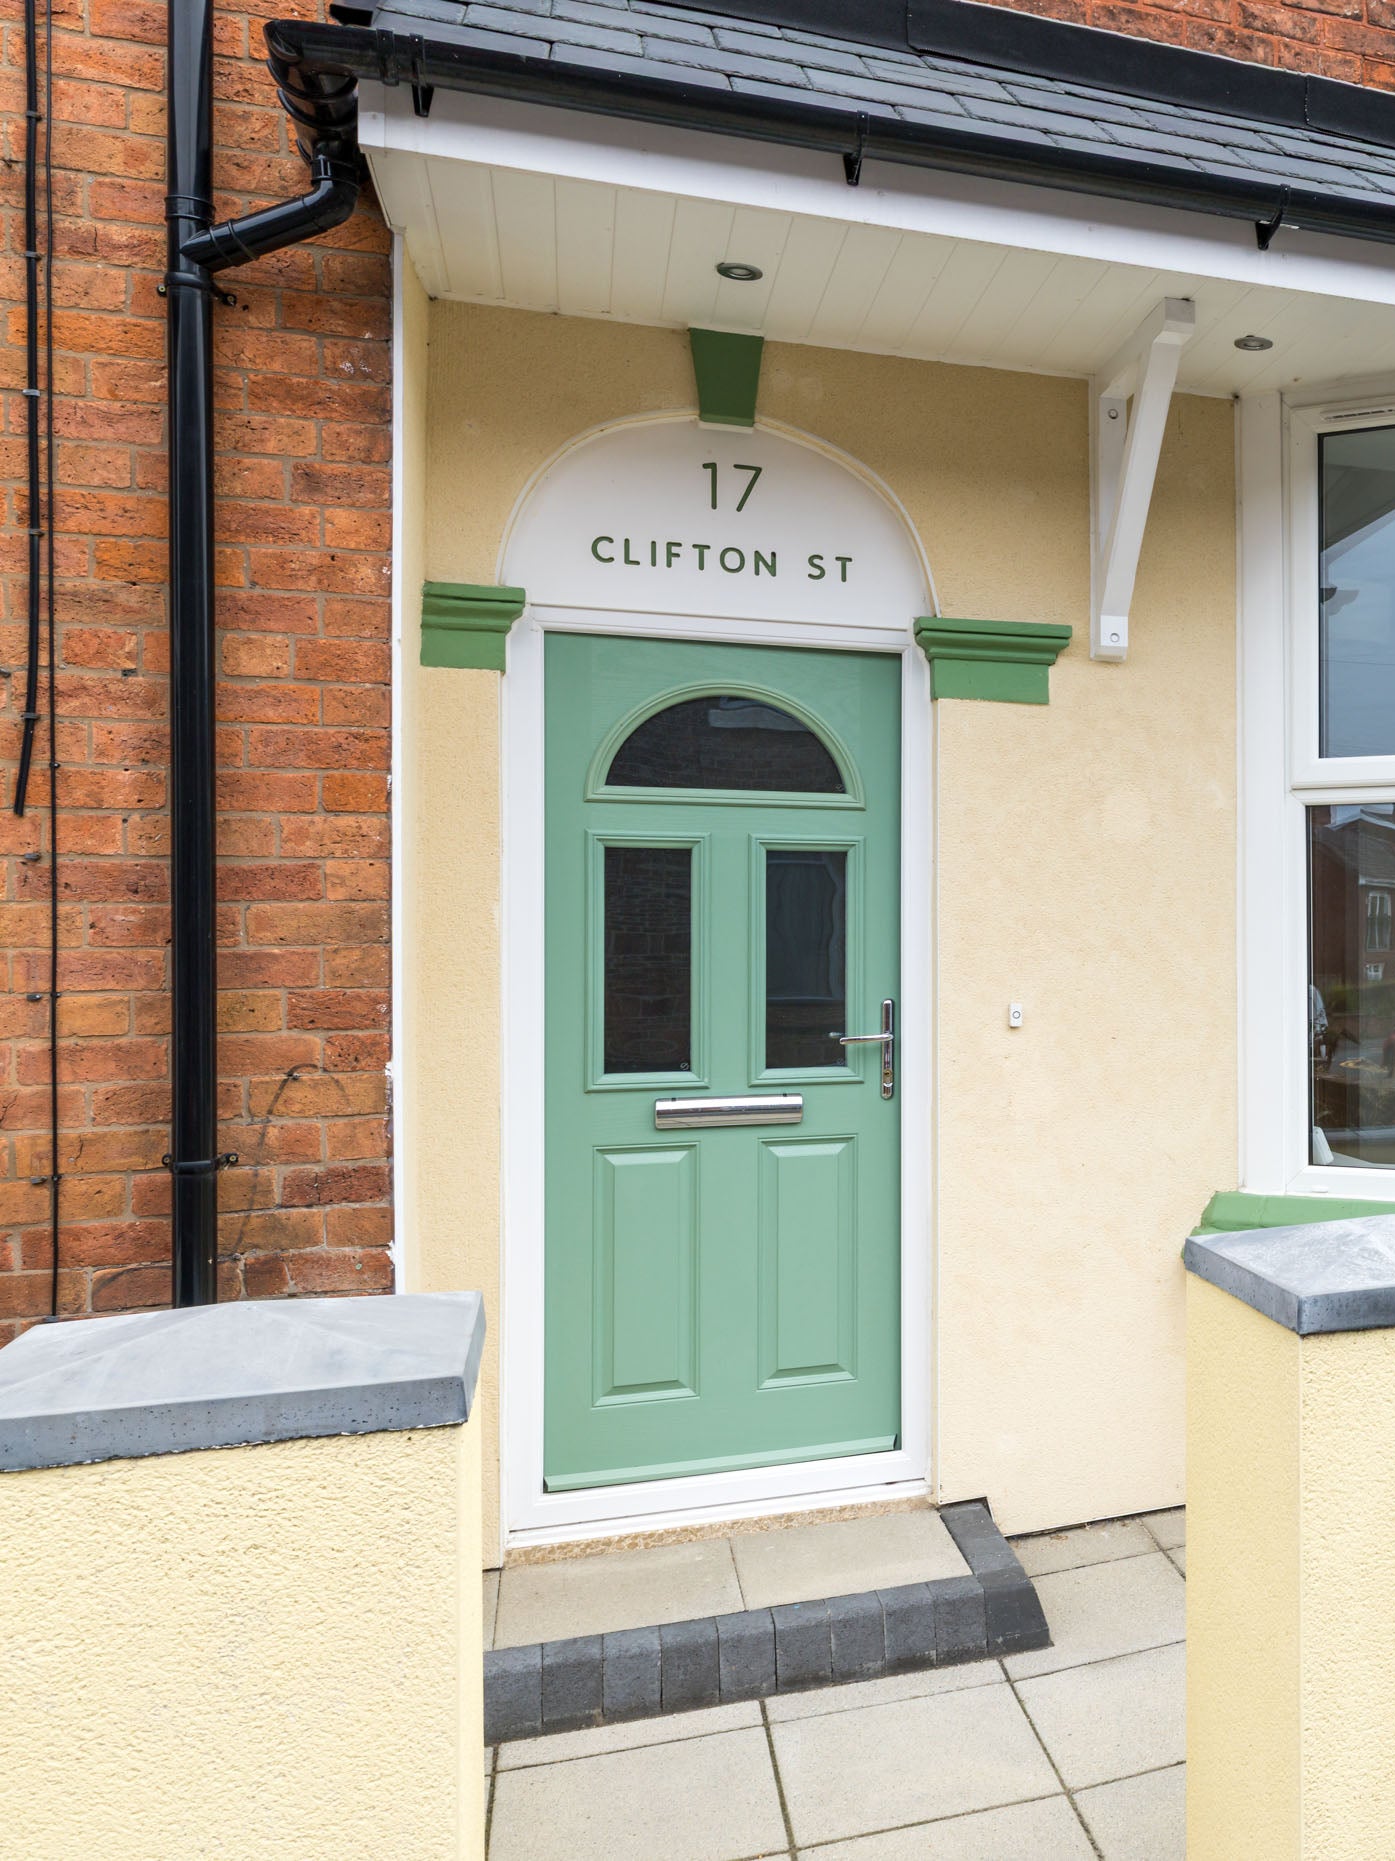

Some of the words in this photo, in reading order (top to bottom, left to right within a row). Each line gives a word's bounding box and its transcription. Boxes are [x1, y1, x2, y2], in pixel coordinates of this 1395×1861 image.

[702, 461, 763, 512] 17
[591, 535, 777, 577] CLIFTON
[807, 554, 853, 583] ST
